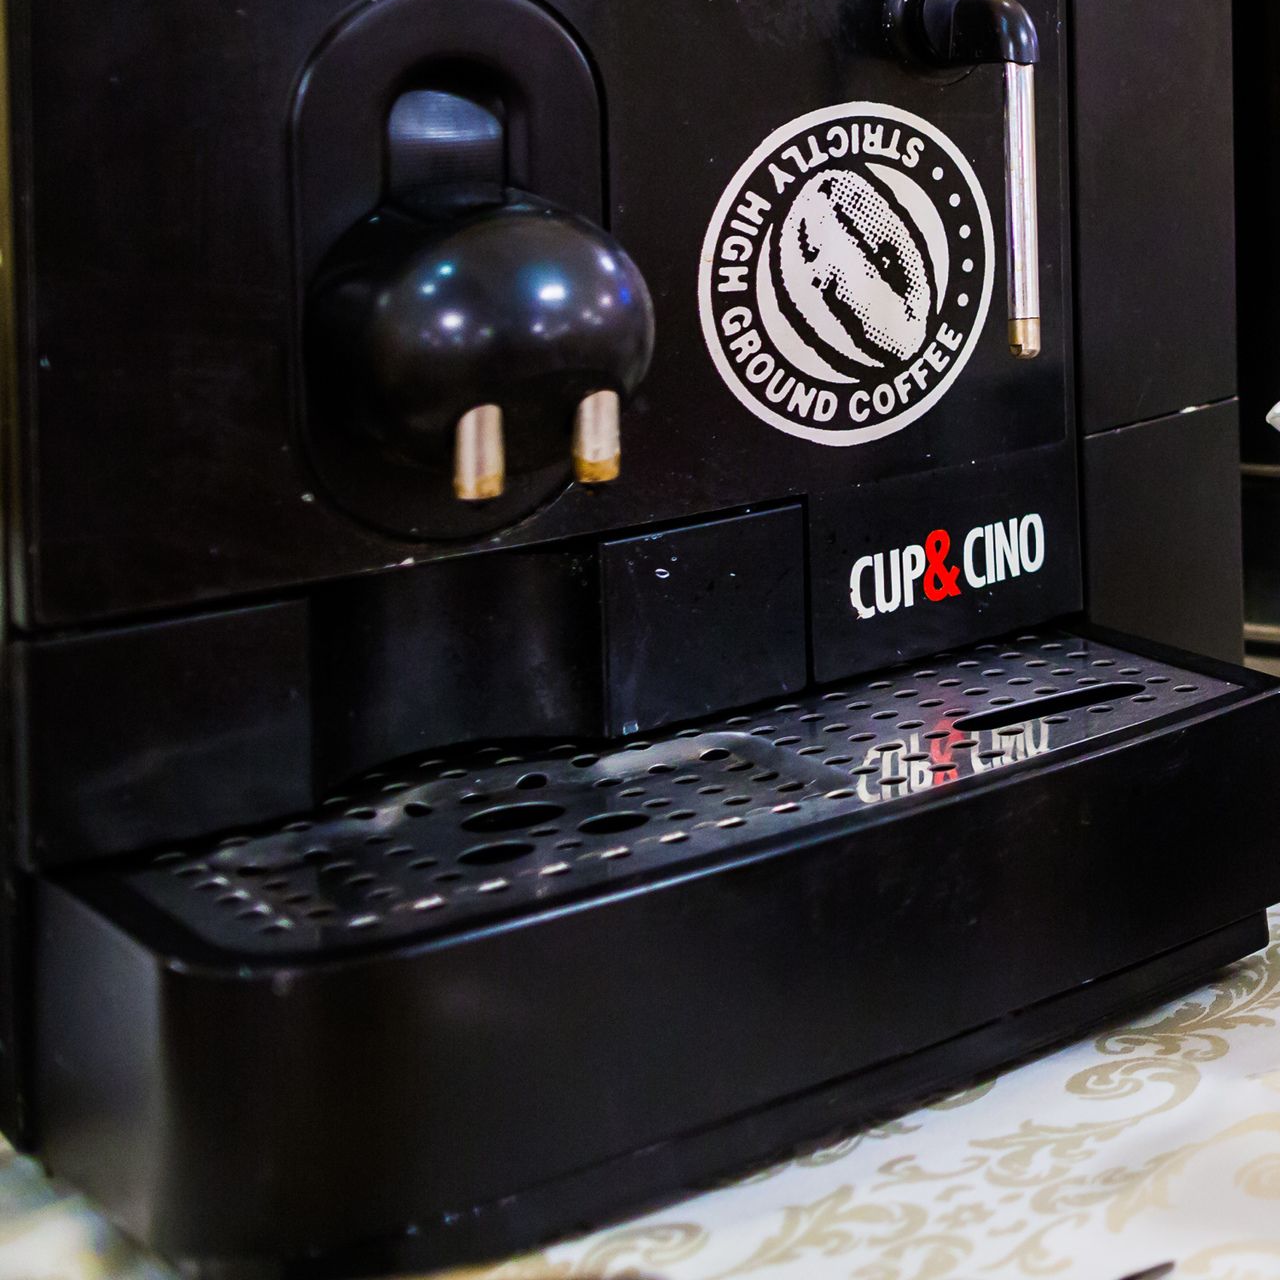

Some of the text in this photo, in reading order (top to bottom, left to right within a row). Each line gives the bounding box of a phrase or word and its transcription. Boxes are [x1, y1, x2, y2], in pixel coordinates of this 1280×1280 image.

[718, 123, 963, 424] STRICTLY HIGH GROUND COFFEE
